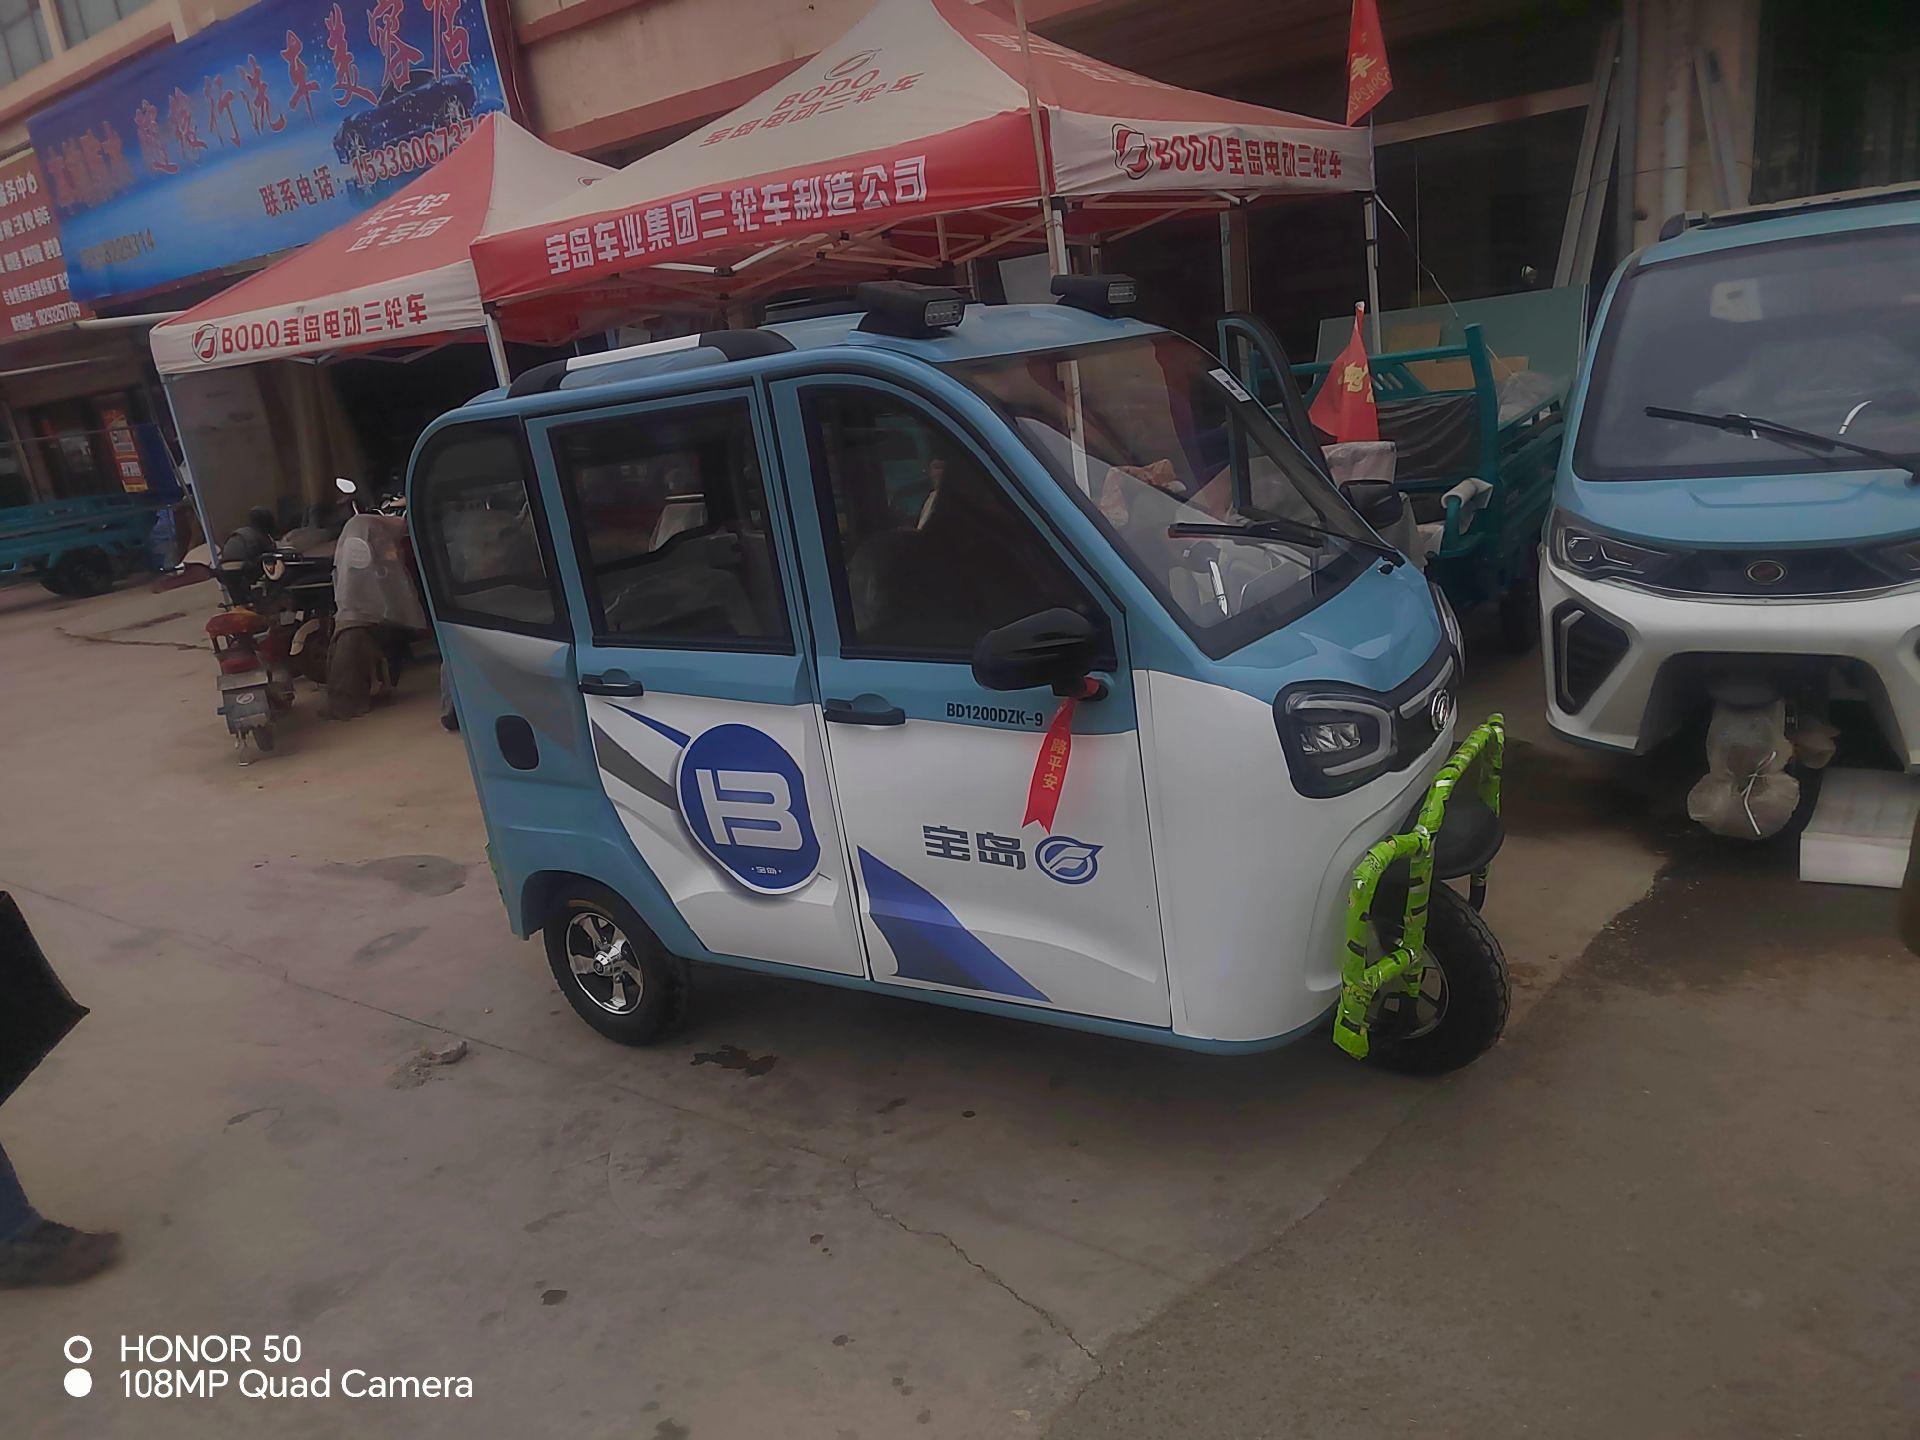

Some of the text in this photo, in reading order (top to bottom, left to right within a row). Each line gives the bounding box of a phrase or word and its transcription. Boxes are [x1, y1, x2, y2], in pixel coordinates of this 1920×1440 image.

[699, 72, 924, 148] 宝岛电动三轮车
[773, 69, 880, 113] BODO
[353, 115, 487, 187] 1533606737
[545, 155, 927, 275] 宝岛车业集团三轮车制造公司
[947, 703, 1043, 726] BD1200DZK-9
[922, 826, 1026, 870] 宝岛
